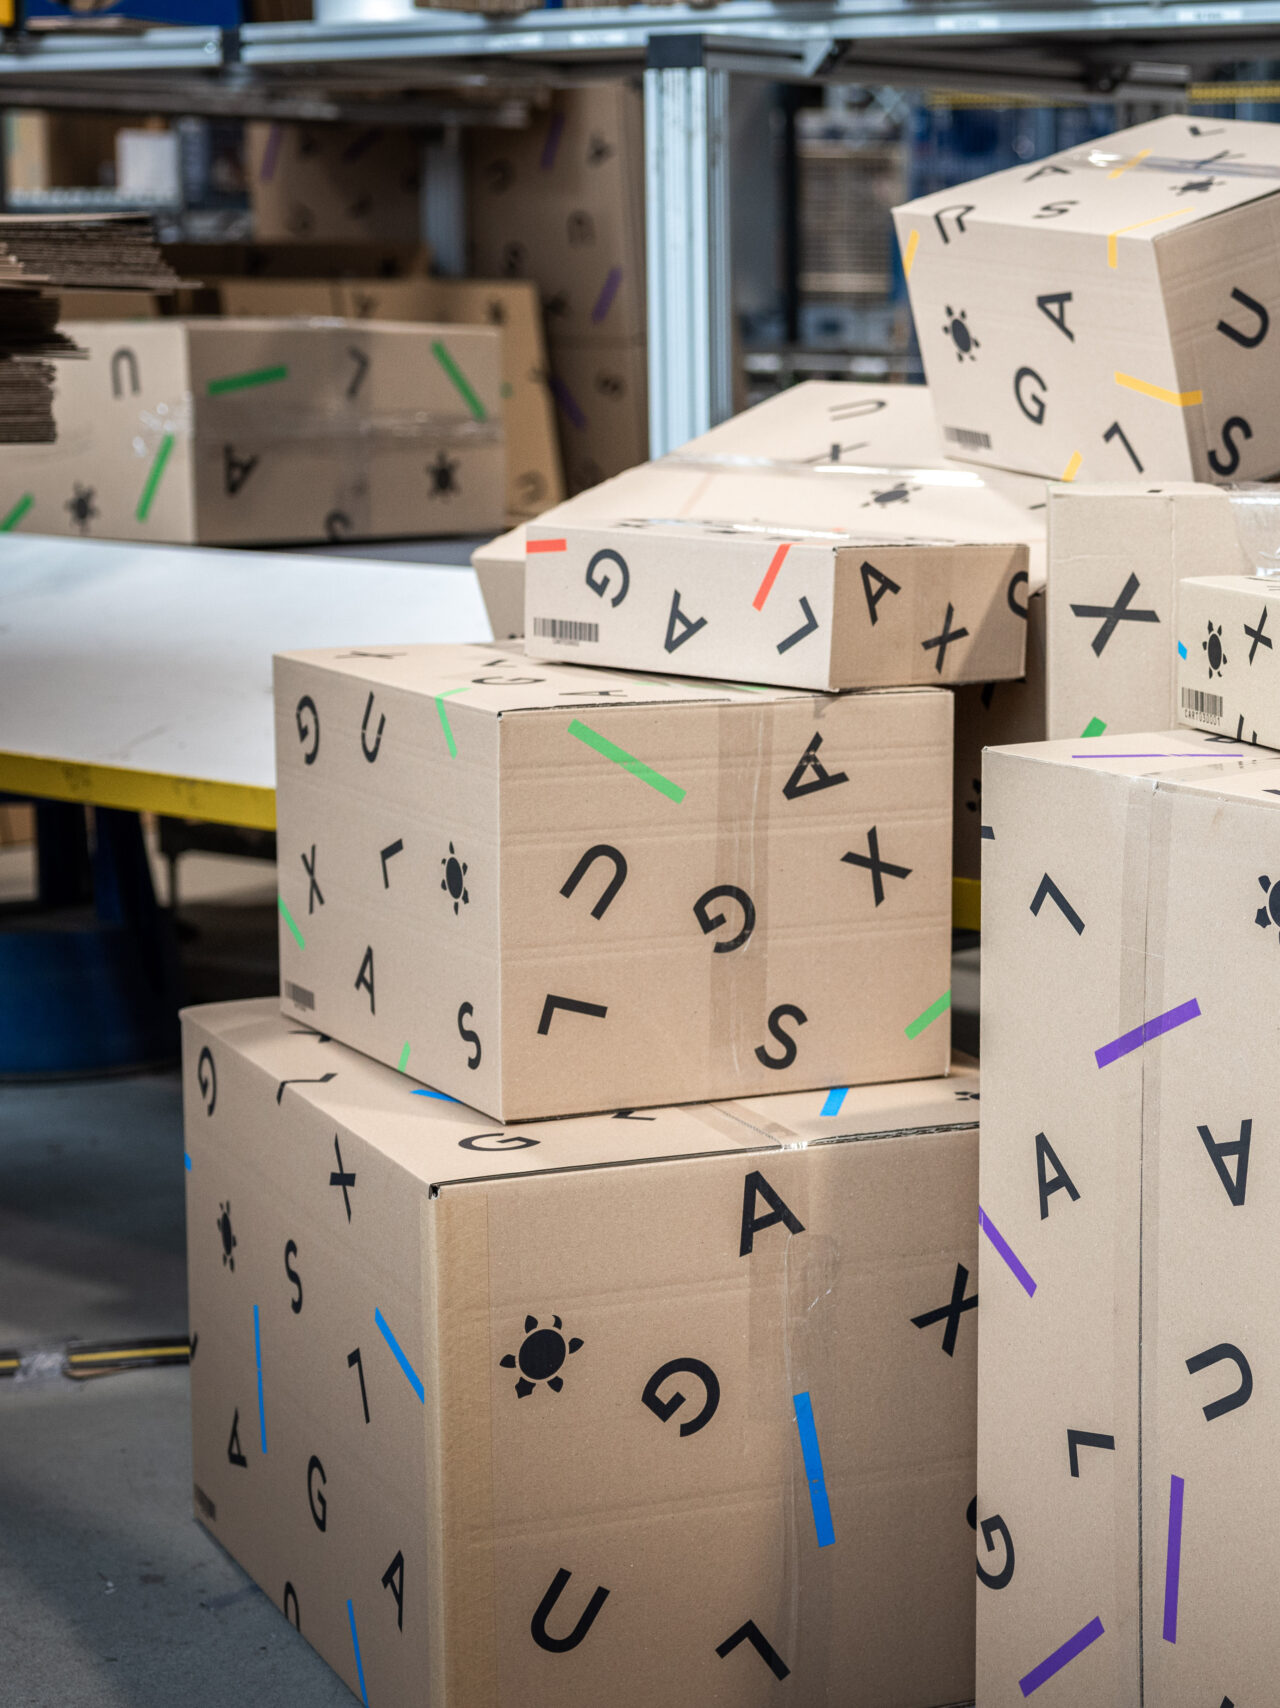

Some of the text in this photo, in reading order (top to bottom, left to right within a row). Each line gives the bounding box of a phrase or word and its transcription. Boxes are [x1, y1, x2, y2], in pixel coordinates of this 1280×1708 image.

[1033, 200, 1080, 220] S
[1037, 291, 1074, 343] A
[1216, 286, 1270, 350] U
[1014, 367, 1047, 424] G
[1103, 422, 1144, 473] L
[1206, 415, 1254, 478] S
[586, 549, 630, 607] G
[859, 560, 902, 627] A
[664, 590, 707, 653] A
[777, 596, 819, 654] L
[921, 602, 970, 675] X
[1070, 572, 1160, 657] X
[1243, 606, 1273, 665] X
[471, 676, 547, 687] G
[295, 694, 320, 766] G
[361, 690, 386, 764] U
[782, 731, 850, 801] A
[300, 844, 325, 915] X
[559, 844, 628, 921] U
[840, 825, 913, 908] X
[692, 884, 756, 954] G
[1029, 872, 1086, 936] L
[354, 944, 376, 1016] A
[536, 993, 608, 1036] L
[457, 1001, 482, 1070] S
[754, 1003, 808, 1070] S
[197, 1045, 218, 1117] G
[458, 1132, 541, 1152] G
[1035, 1132, 1081, 1221] A
[1196, 1118, 1253, 1207] A
[328, 1132, 357, 1224] X
[739, 1170, 806, 1258] A
[284, 1239, 303, 1315] S
[909, 1261, 979, 1358] X
[640, 1357, 721, 1438] G
[1185, 1342, 1254, 1422] U
[1066, 1428, 1116, 1478] L
[307, 1454, 327, 1533] G
[975, 1514, 1016, 1591] G
[381, 1549, 405, 1633] A
[530, 1567, 611, 1654] U
[714, 1619, 791, 1682] L
